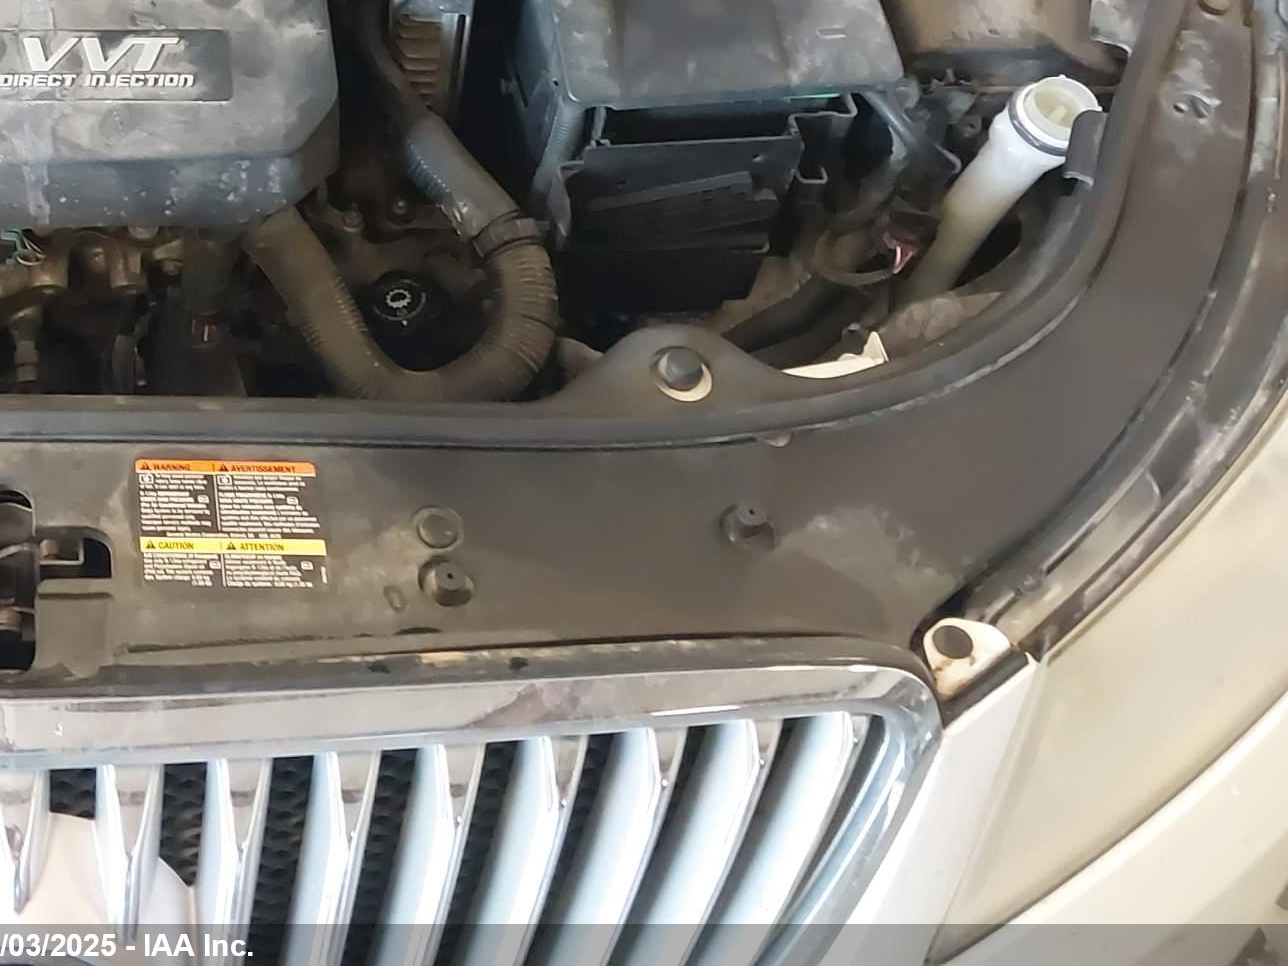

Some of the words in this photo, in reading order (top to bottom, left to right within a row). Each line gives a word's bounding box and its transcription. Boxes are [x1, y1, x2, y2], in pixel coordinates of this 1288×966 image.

[22, 37, 181, 72] VVT
[84, 74, 194, 88] INJECTION
[152, 463, 190, 471] WARNING
[231, 464, 295, 473] AVERTISSEMENT
[158, 542, 194, 550] CAUTION
[239, 543, 284, 551] ATTENTION
